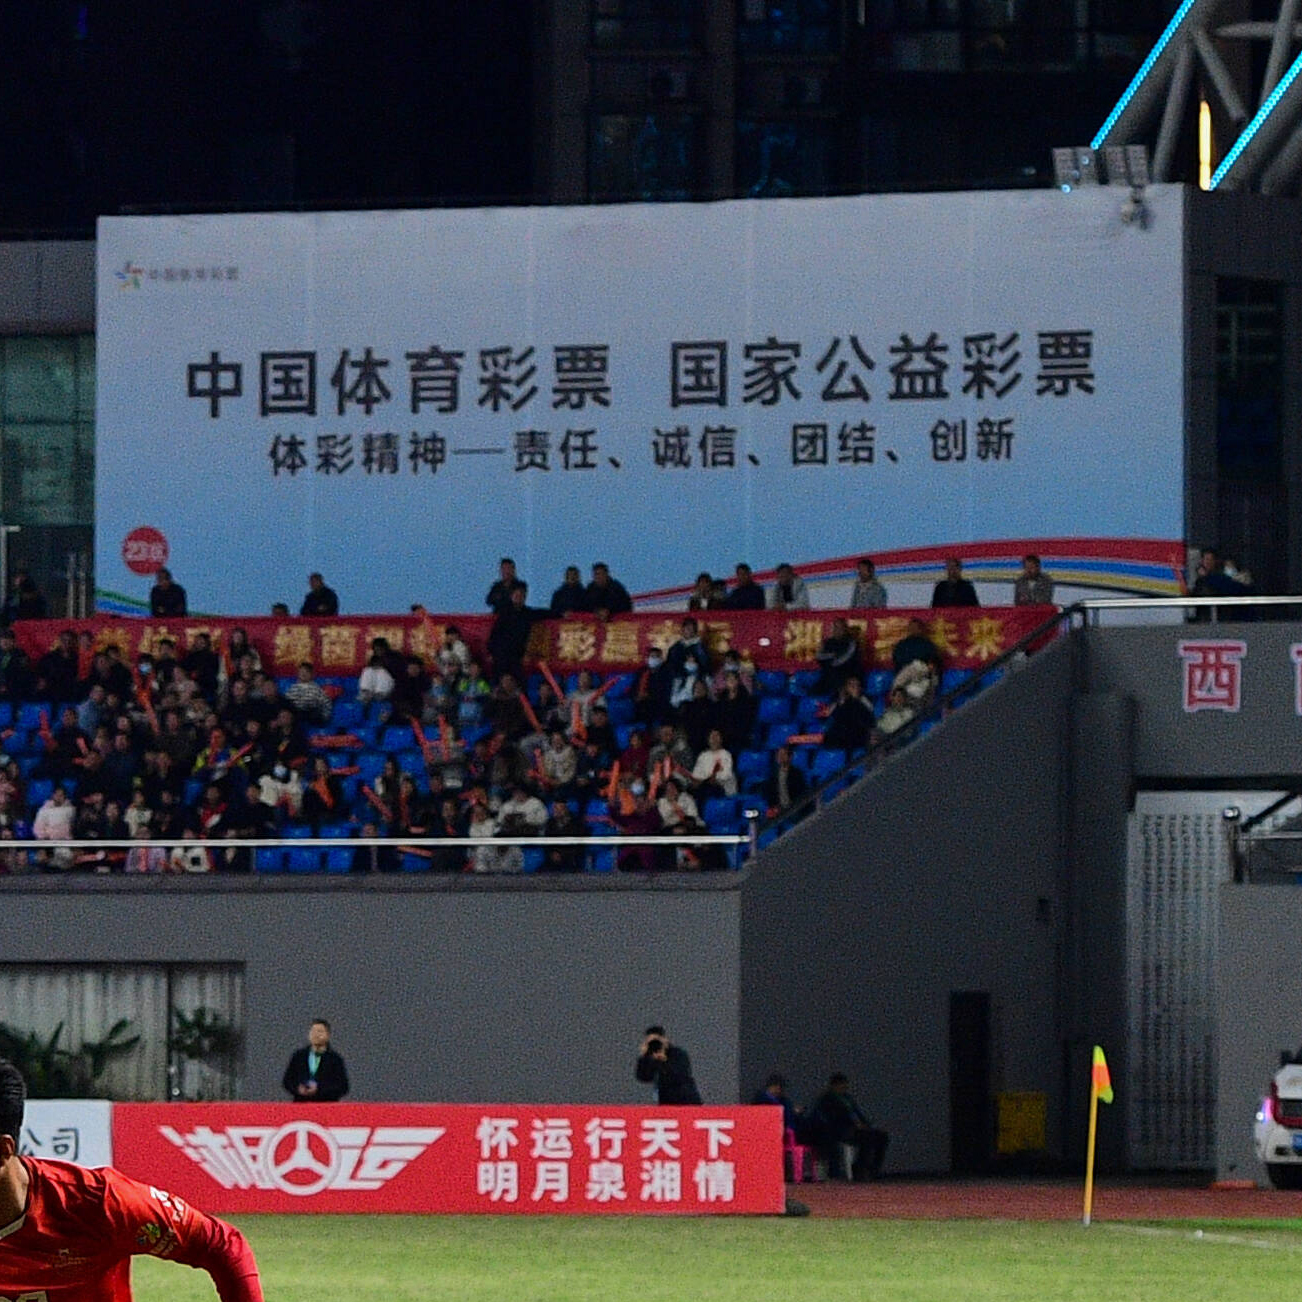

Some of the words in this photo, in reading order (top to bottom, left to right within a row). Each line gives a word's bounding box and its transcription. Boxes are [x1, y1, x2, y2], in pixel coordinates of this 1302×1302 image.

[186, 344, 612, 418] 中国体育彩票
[670, 329, 1096, 408] 国家公益彩票
[476, 1117, 735, 1158] 怀运行天下
[476, 1161, 736, 1201] 明月泉湘情
